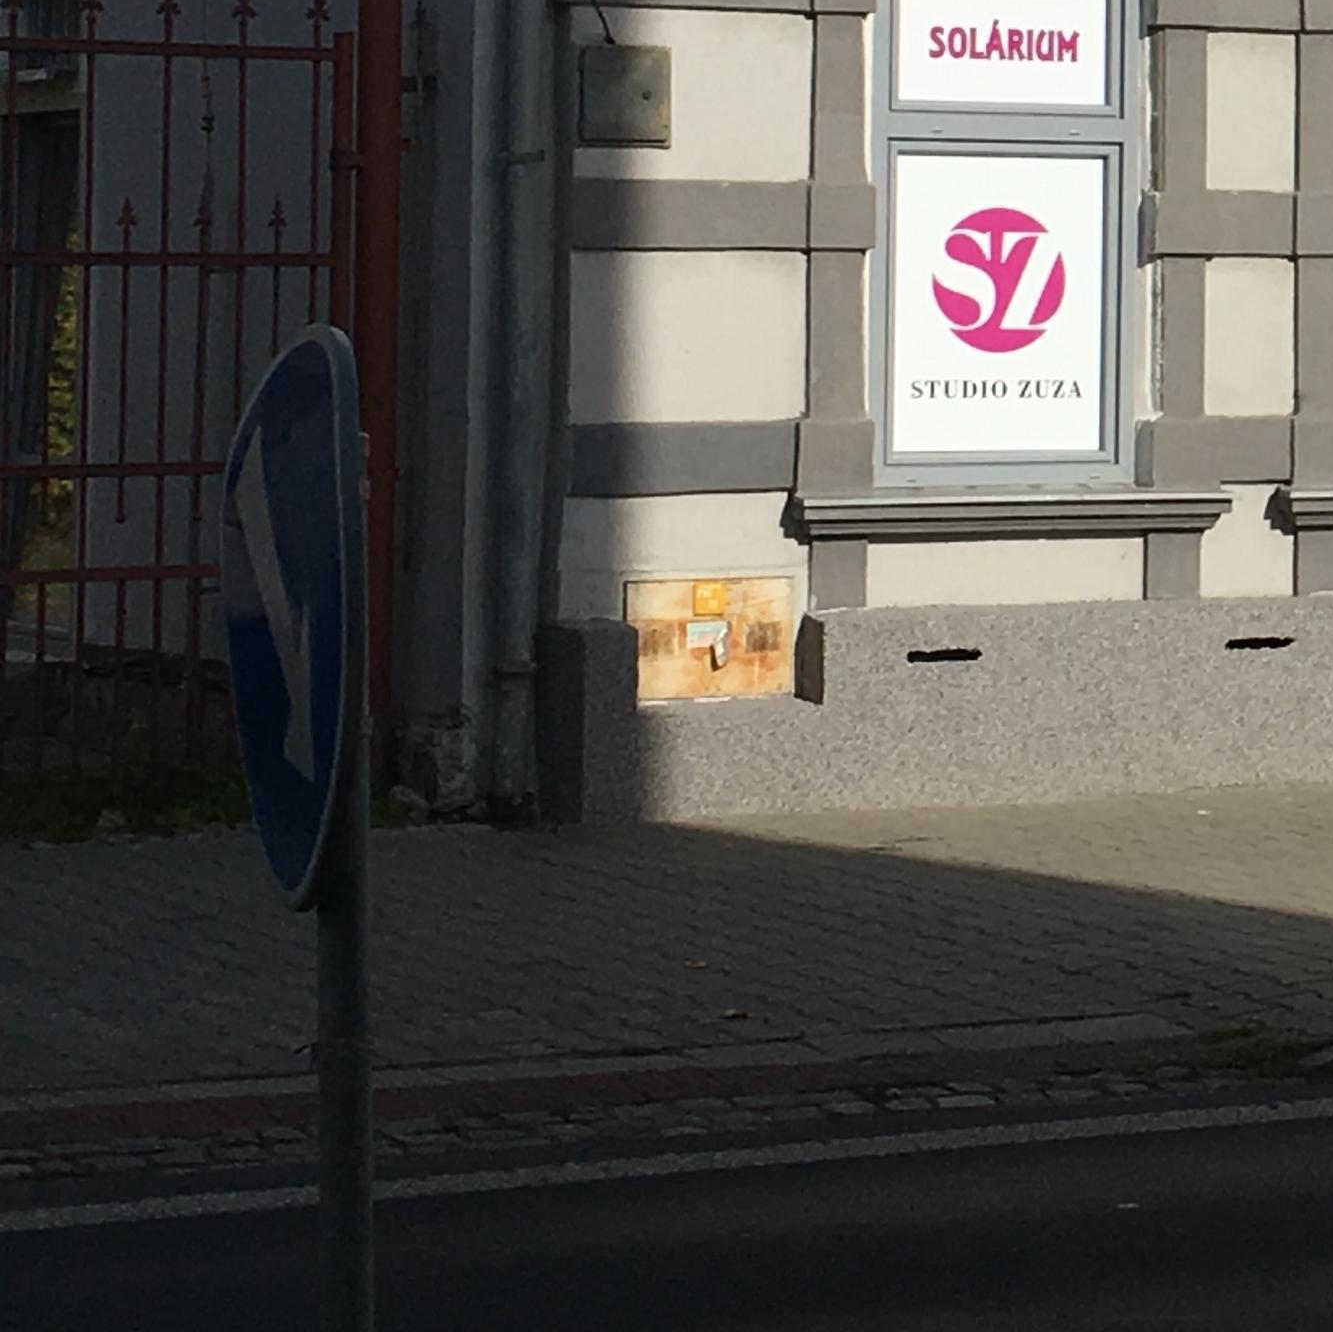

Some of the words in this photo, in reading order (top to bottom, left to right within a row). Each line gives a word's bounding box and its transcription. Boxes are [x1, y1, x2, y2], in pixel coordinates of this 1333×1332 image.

[929, 19, 1079, 62] SOLÁRIUM
[910, 379, 1008, 399] STUDIO
[1018, 379, 1083, 399] ZUZA
